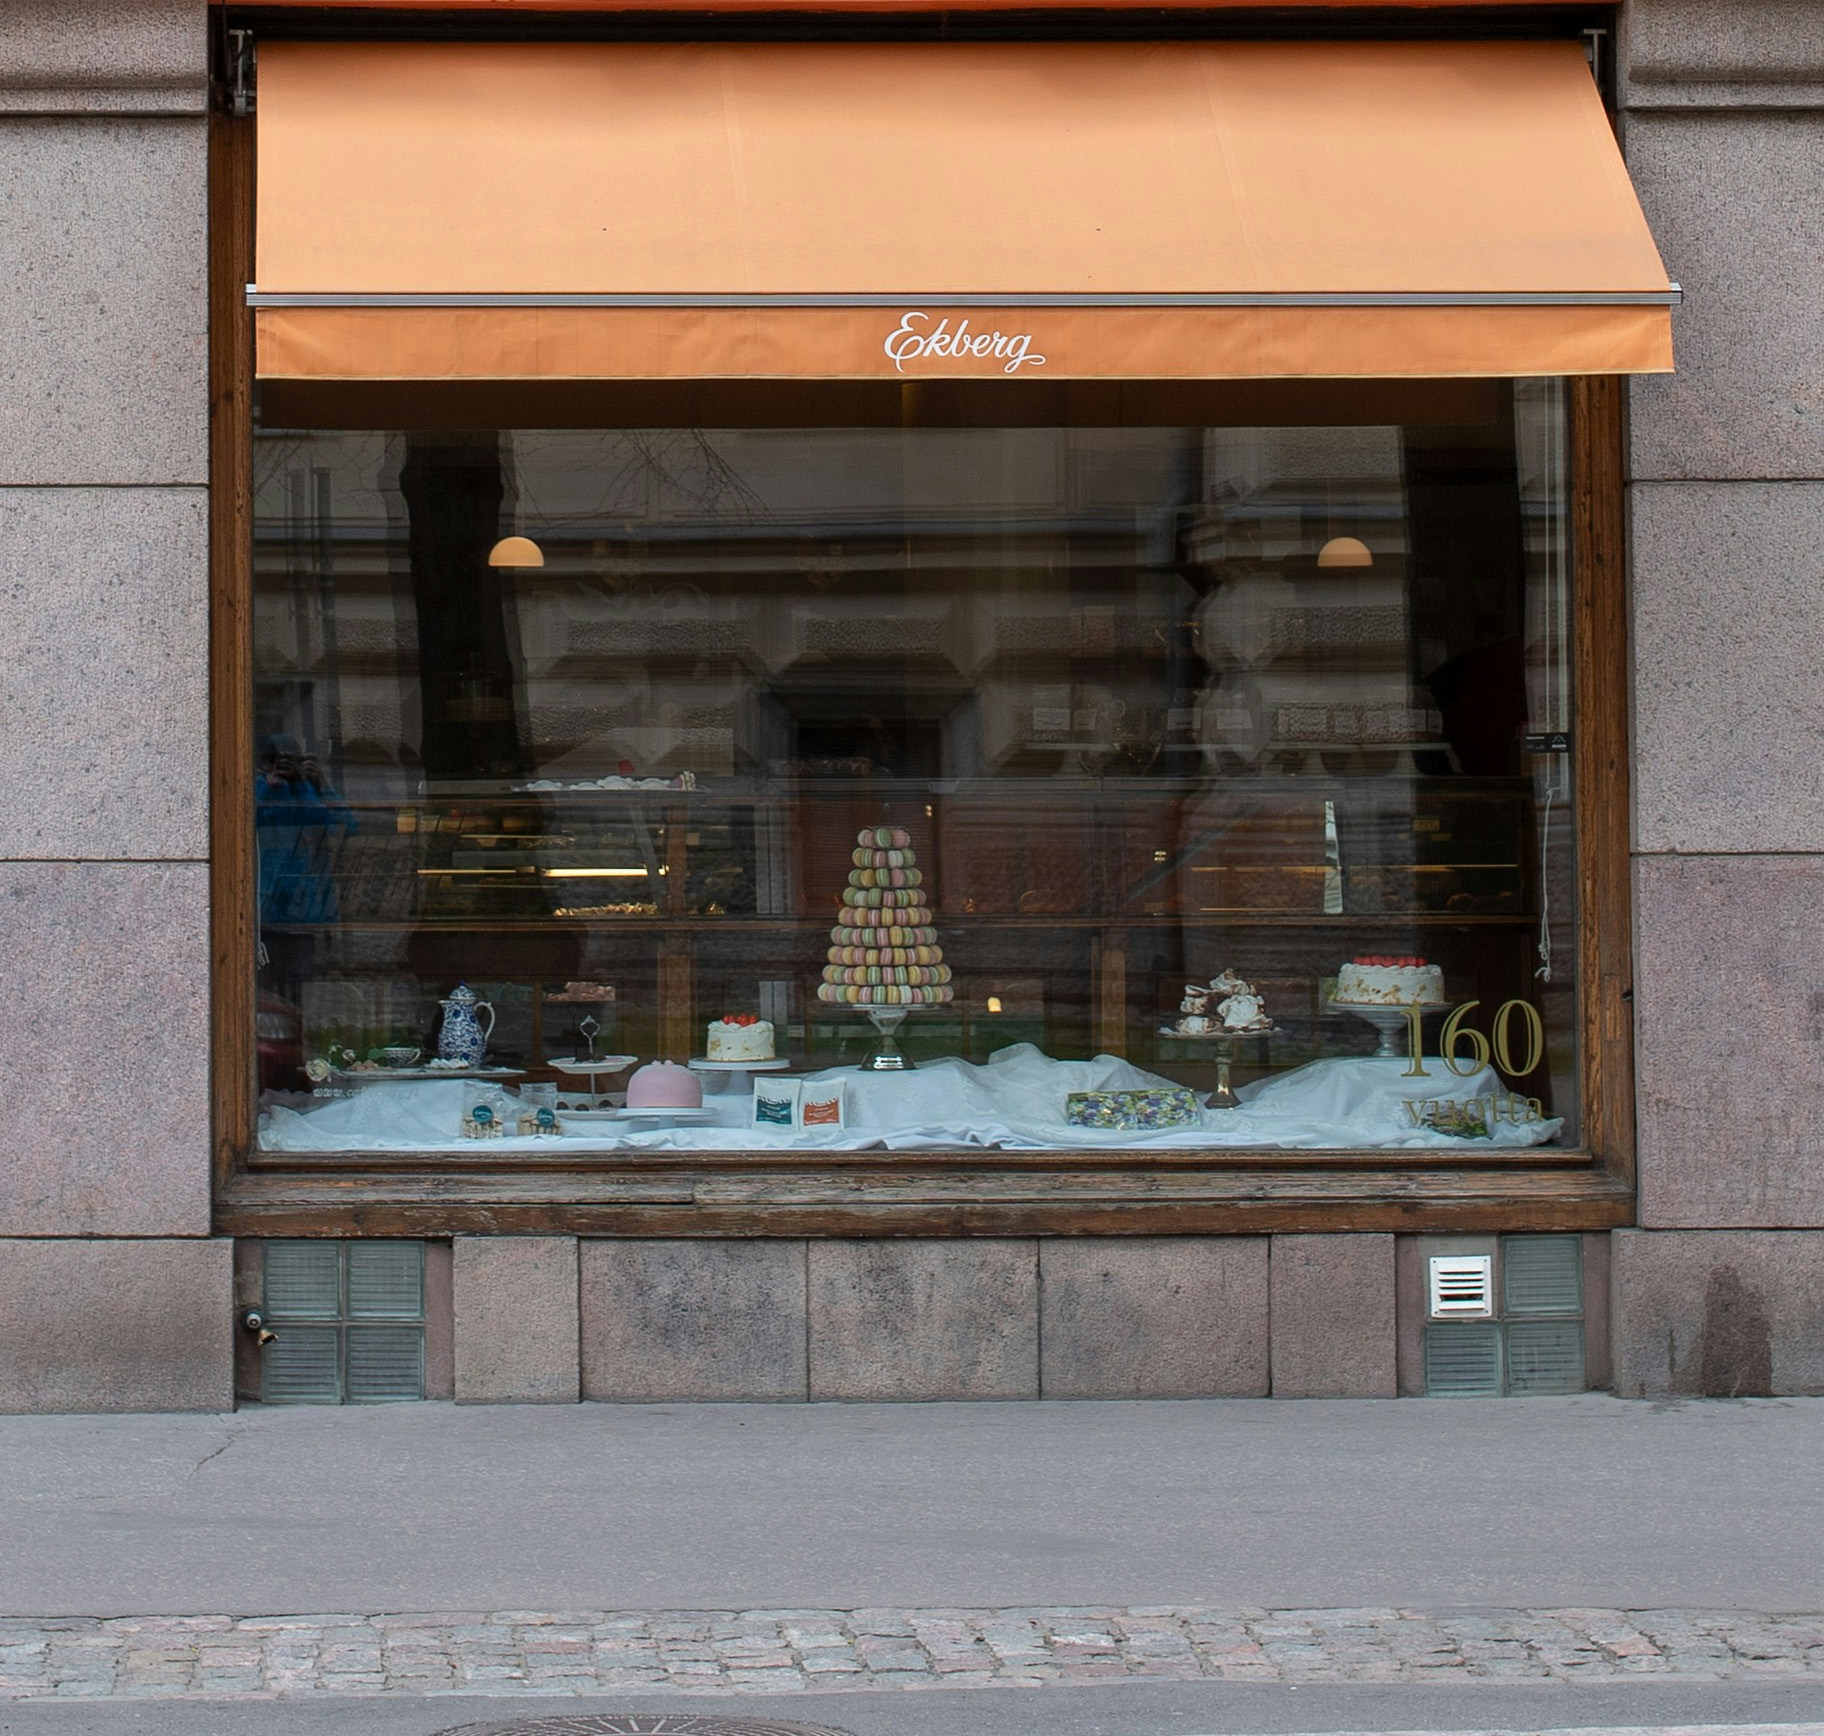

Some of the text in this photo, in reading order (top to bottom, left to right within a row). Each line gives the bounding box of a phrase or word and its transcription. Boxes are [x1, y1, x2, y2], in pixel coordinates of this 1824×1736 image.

[883, 311, 1046, 374] Ekberg
[1399, 999, 1543, 1078] 160
[1401, 1091, 1544, 1124] vuotta
